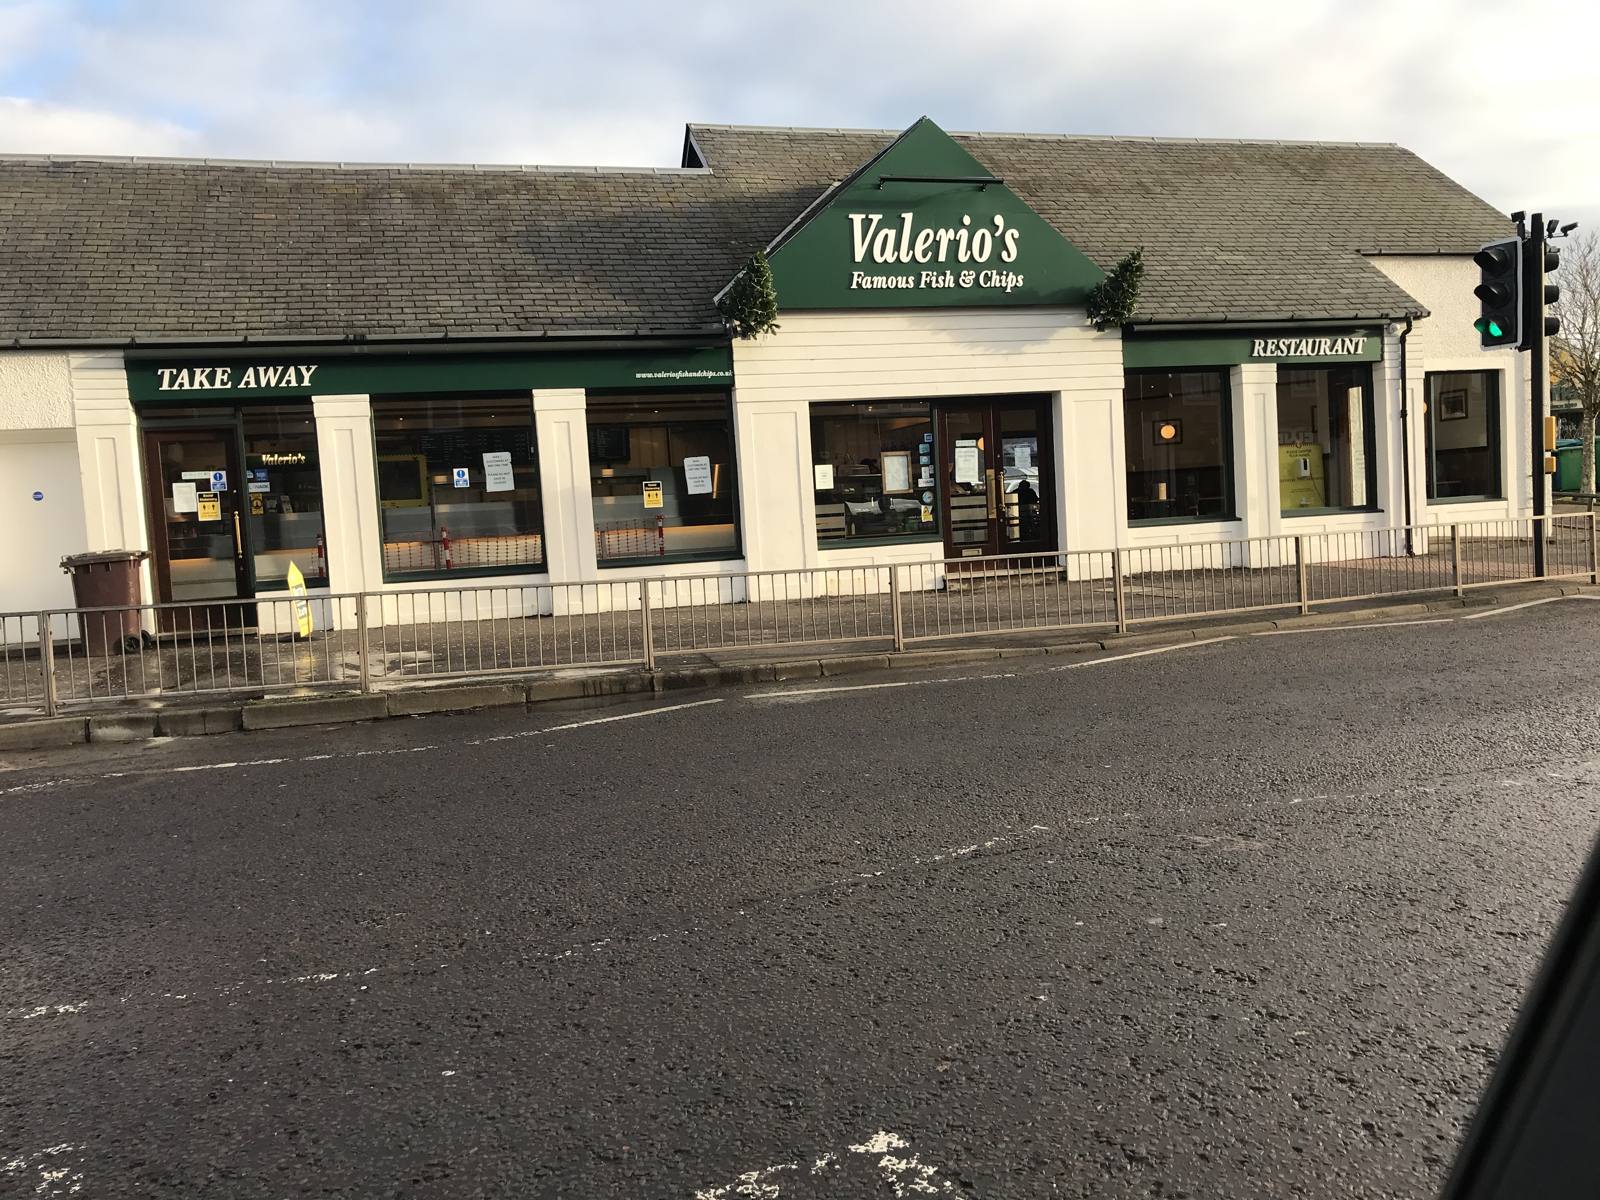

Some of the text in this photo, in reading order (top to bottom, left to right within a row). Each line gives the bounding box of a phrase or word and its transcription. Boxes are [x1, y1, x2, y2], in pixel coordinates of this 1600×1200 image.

[848, 212, 1020, 264] Valerio's
[850, 269, 1024, 293] Famous Fish & Chips
[1251, 336, 1368, 357] RESTAURANT
[157, 364, 319, 391] TAKE AWAY
[261, 452, 306, 466] Valerio's
